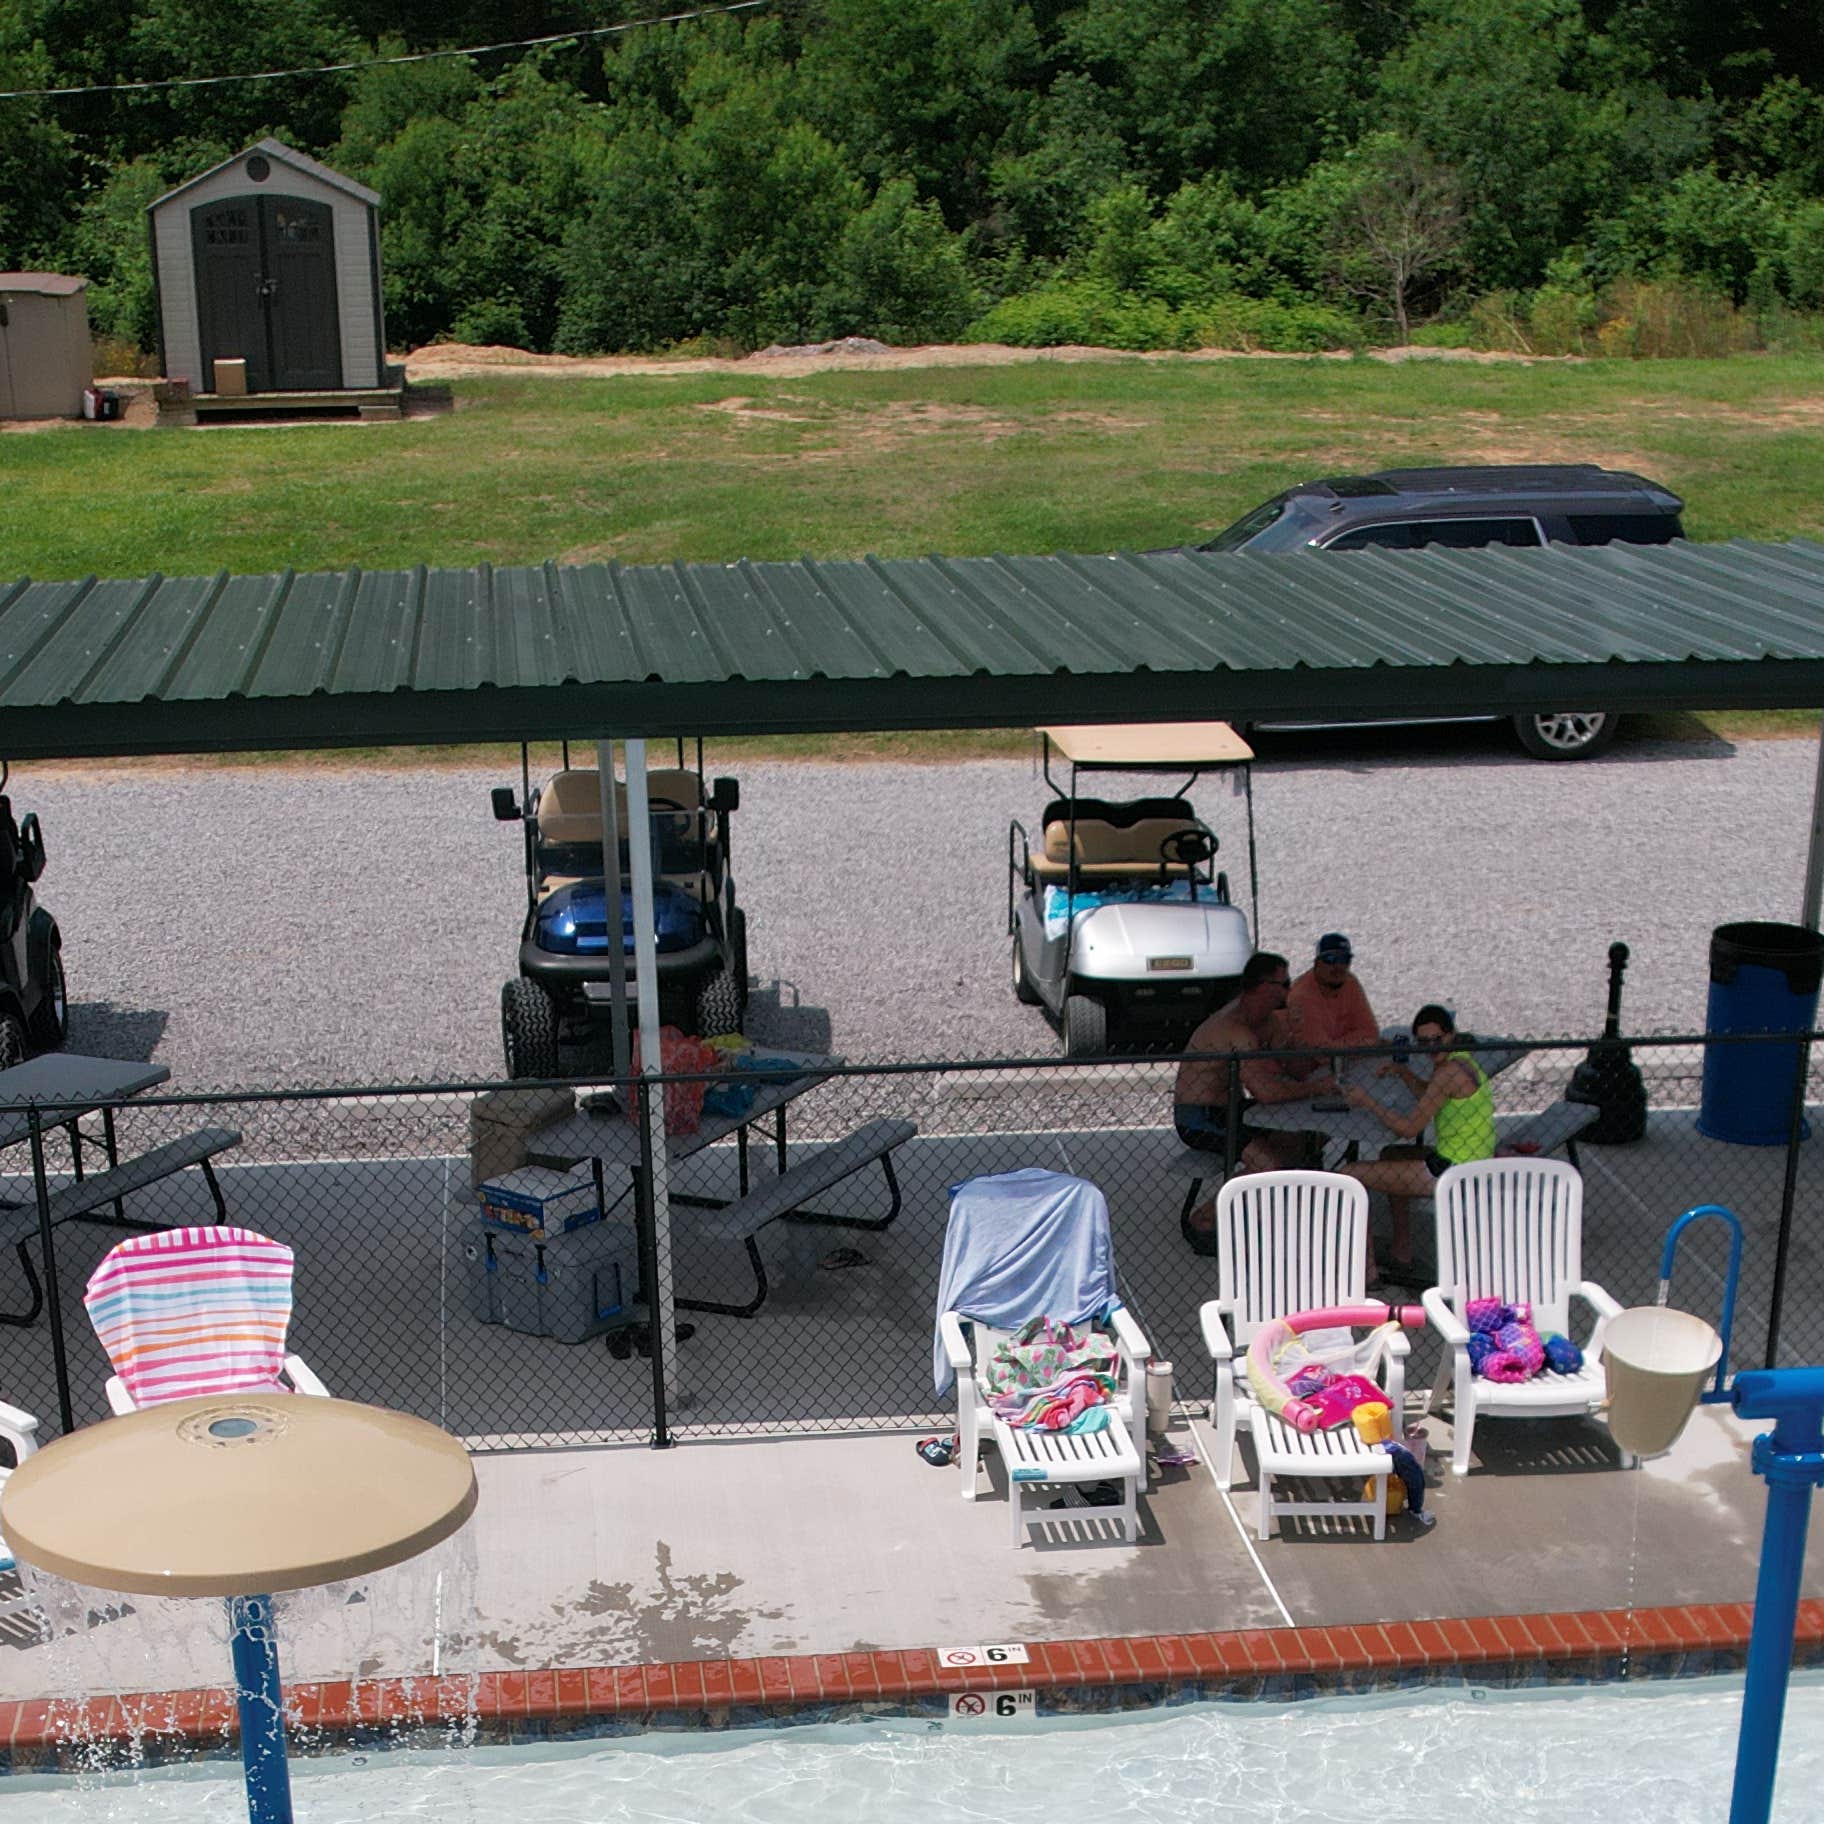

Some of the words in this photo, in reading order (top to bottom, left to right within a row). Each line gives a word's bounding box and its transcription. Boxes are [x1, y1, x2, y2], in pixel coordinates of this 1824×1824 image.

[987, 1648, 1008, 1662] 6
[996, 1694, 1017, 1717] 6
[1018, 1693, 1033, 1704] IN
